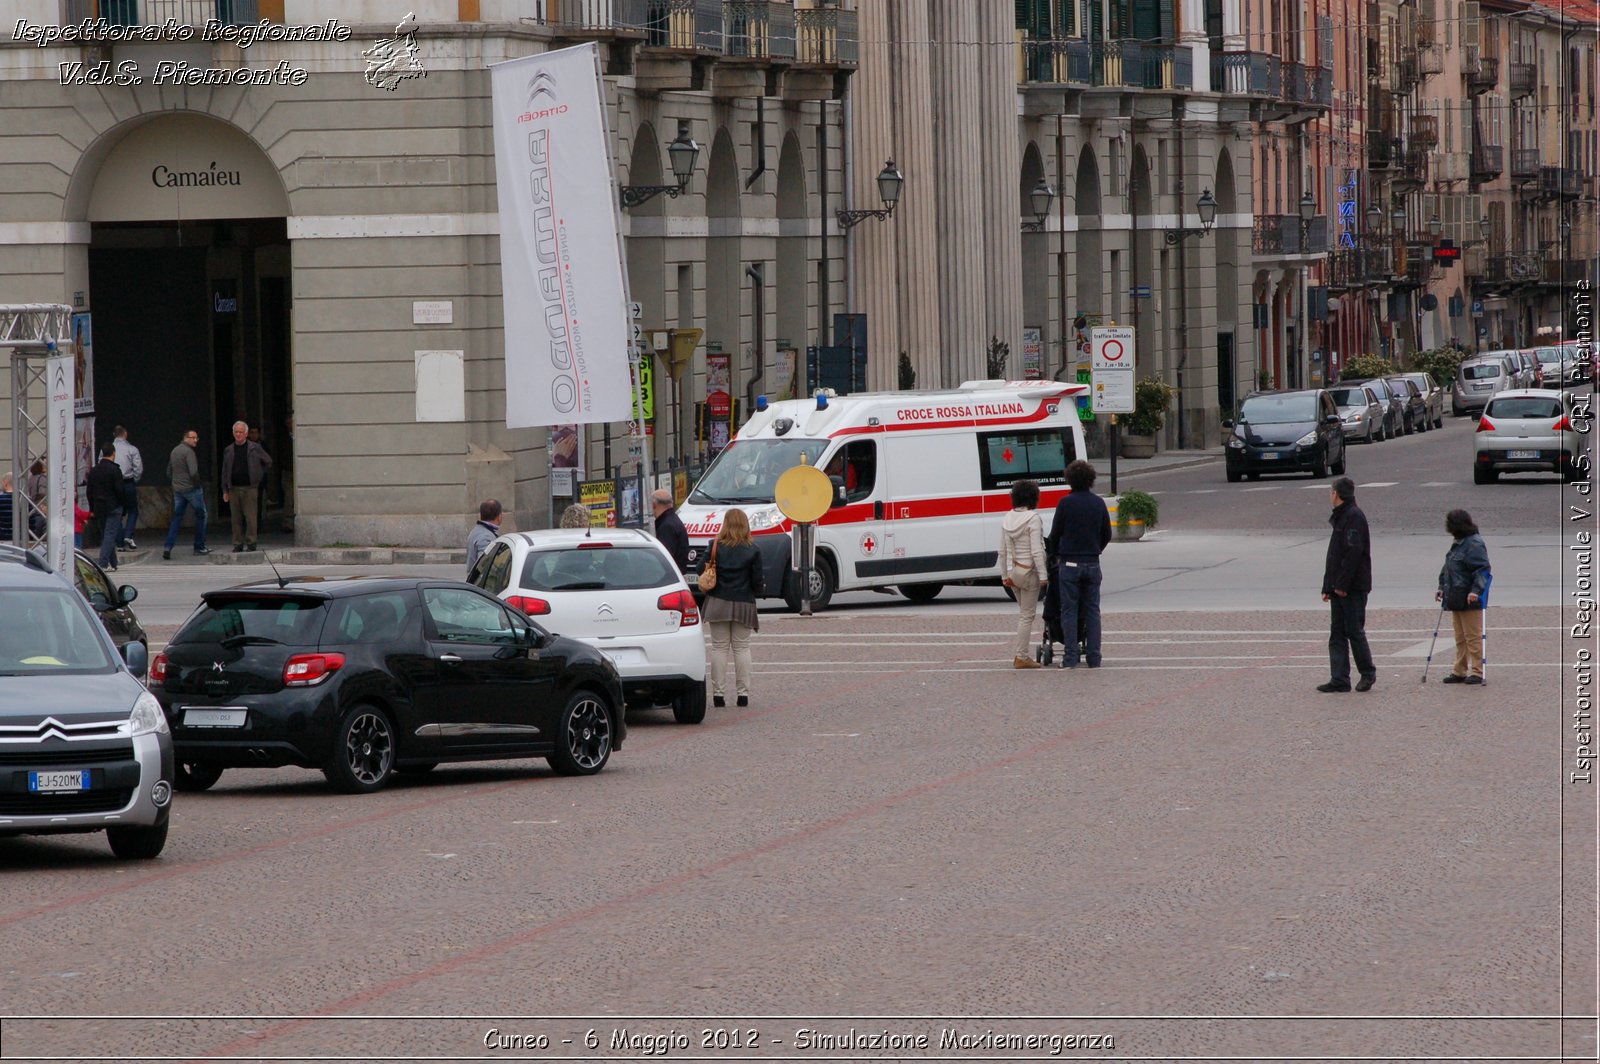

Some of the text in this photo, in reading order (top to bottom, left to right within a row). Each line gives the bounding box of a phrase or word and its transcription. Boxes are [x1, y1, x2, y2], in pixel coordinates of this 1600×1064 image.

[897, 402, 1024, 421] CROCE ROSSA ITALIANA
